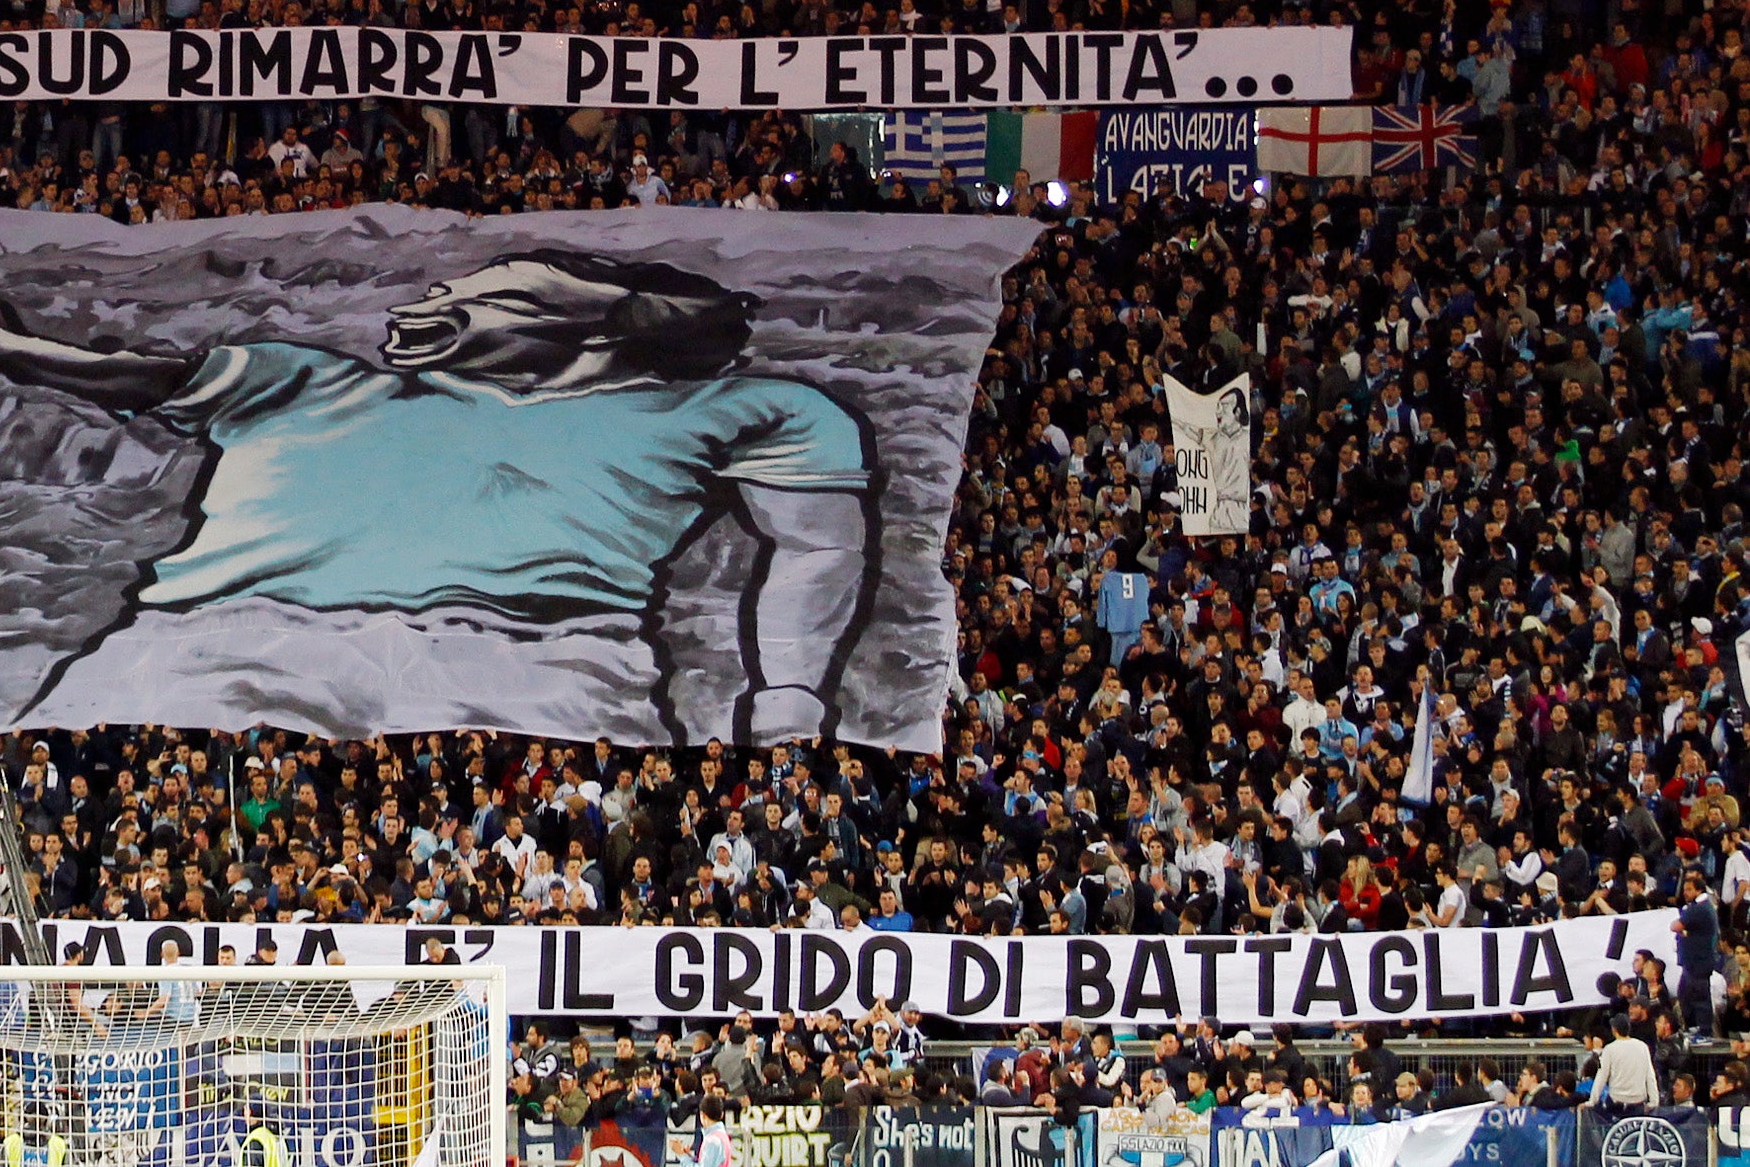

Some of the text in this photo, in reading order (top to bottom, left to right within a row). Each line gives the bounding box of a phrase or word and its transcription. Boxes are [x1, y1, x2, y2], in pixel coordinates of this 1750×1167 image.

[168, 28, 521, 99] RIMARRA'
[566, 38, 700, 105] PER
[1105, 111, 1248, 152] AVANGUARDIA
[1107, 163, 1248, 203] LAZIAE
[1176, 448, 1208, 480] ONG
[1178, 485, 1207, 514] OHN
[1122, 573, 1134, 600] 9
[538, 930, 615, 1010] IL
[654, 931, 914, 1013] GRIDO
[947, 939, 1023, 1017] DI
[725, 1104, 822, 1134] LAZIO
[873, 1104, 975, 1150] She's not
